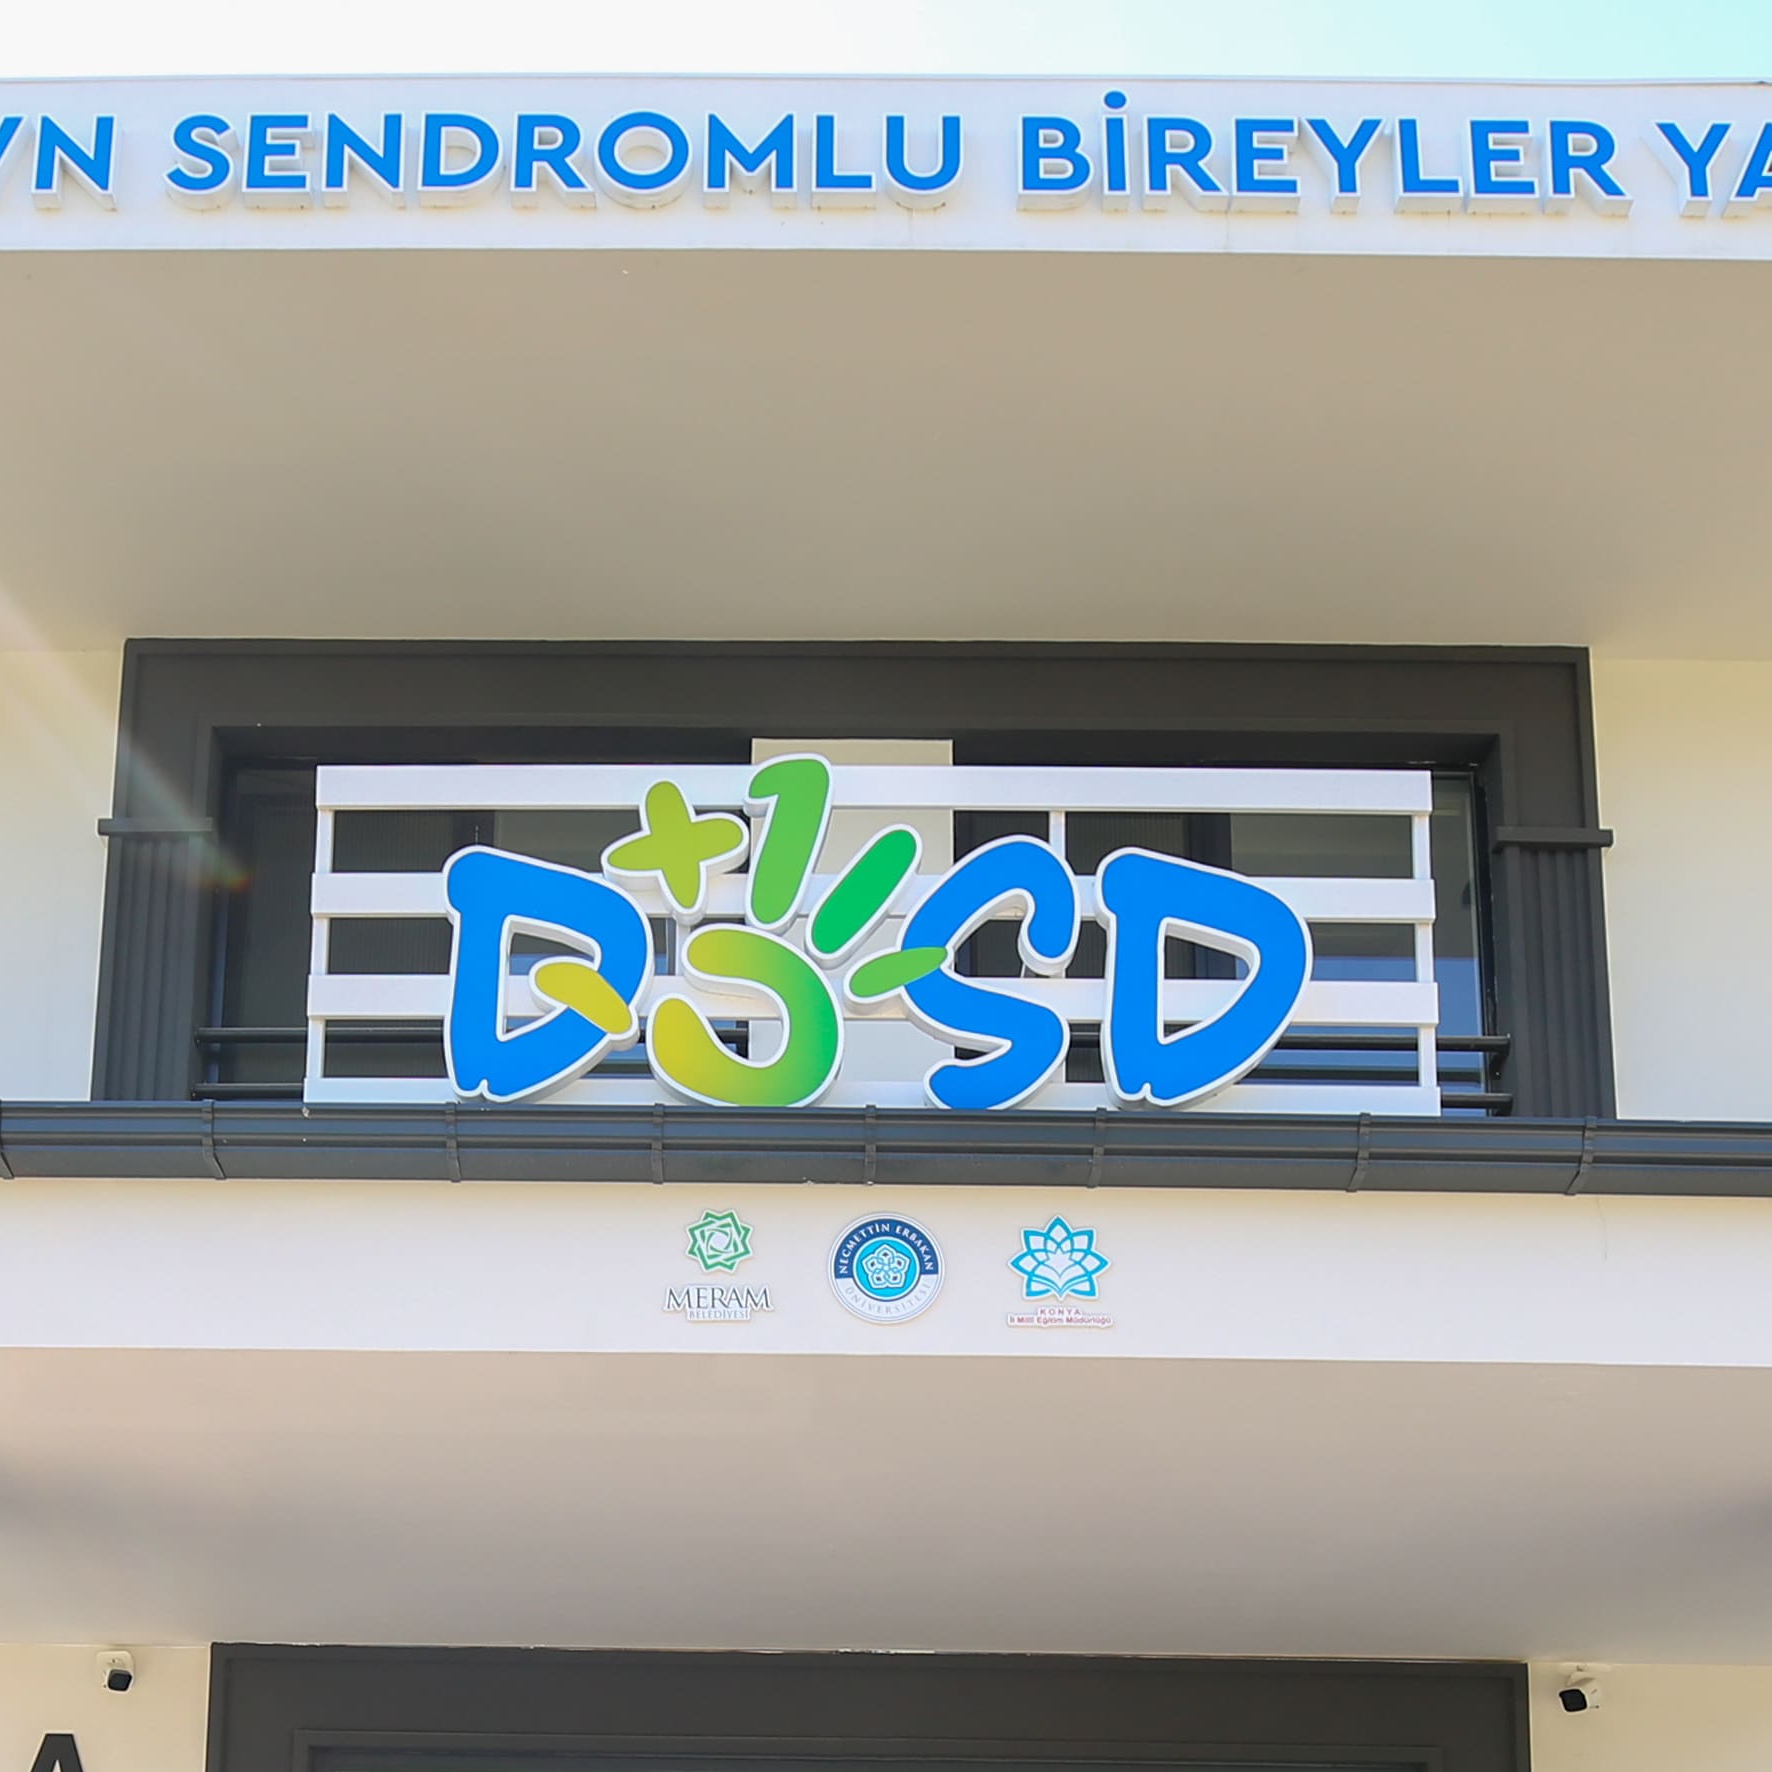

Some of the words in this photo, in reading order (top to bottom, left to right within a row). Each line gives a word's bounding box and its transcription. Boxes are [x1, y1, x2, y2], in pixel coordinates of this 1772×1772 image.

[165, 110, 963, 192] SENDROMLU
[1020, 91, 1627, 197] BİREYLER
[442, 835, 1313, 1110] DOSD
[838, 1222, 890, 1275] NECMETTİN
[895, 1225, 934, 1271] ERBAKAN
[667, 1286, 770, 1310] MERAM
[1039, 1308, 1081, 1316] KONYA
